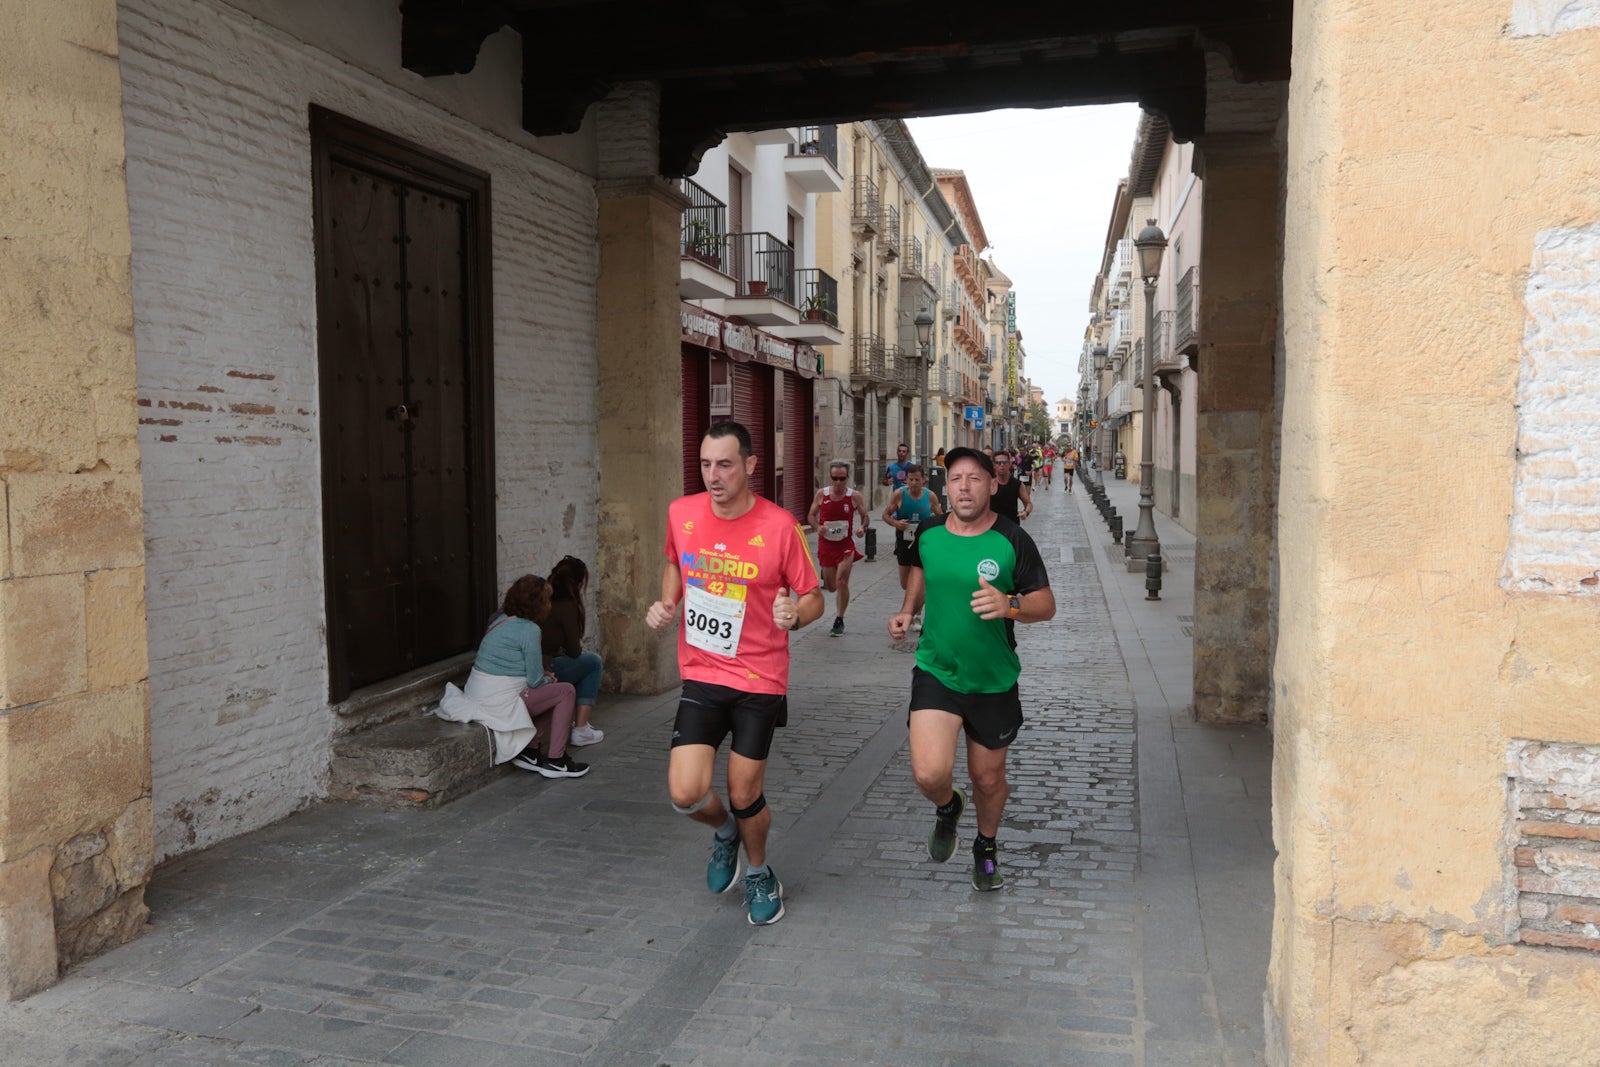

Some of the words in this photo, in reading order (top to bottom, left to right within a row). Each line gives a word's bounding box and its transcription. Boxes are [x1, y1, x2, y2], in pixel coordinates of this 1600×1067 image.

[1008, 291, 1016, 333] TEJIDOS
[681, 551, 759, 580] MADRID
[687, 570, 748, 585] MARATHON
[707, 581, 725, 594] 42
[687, 608, 733, 639] 3093
